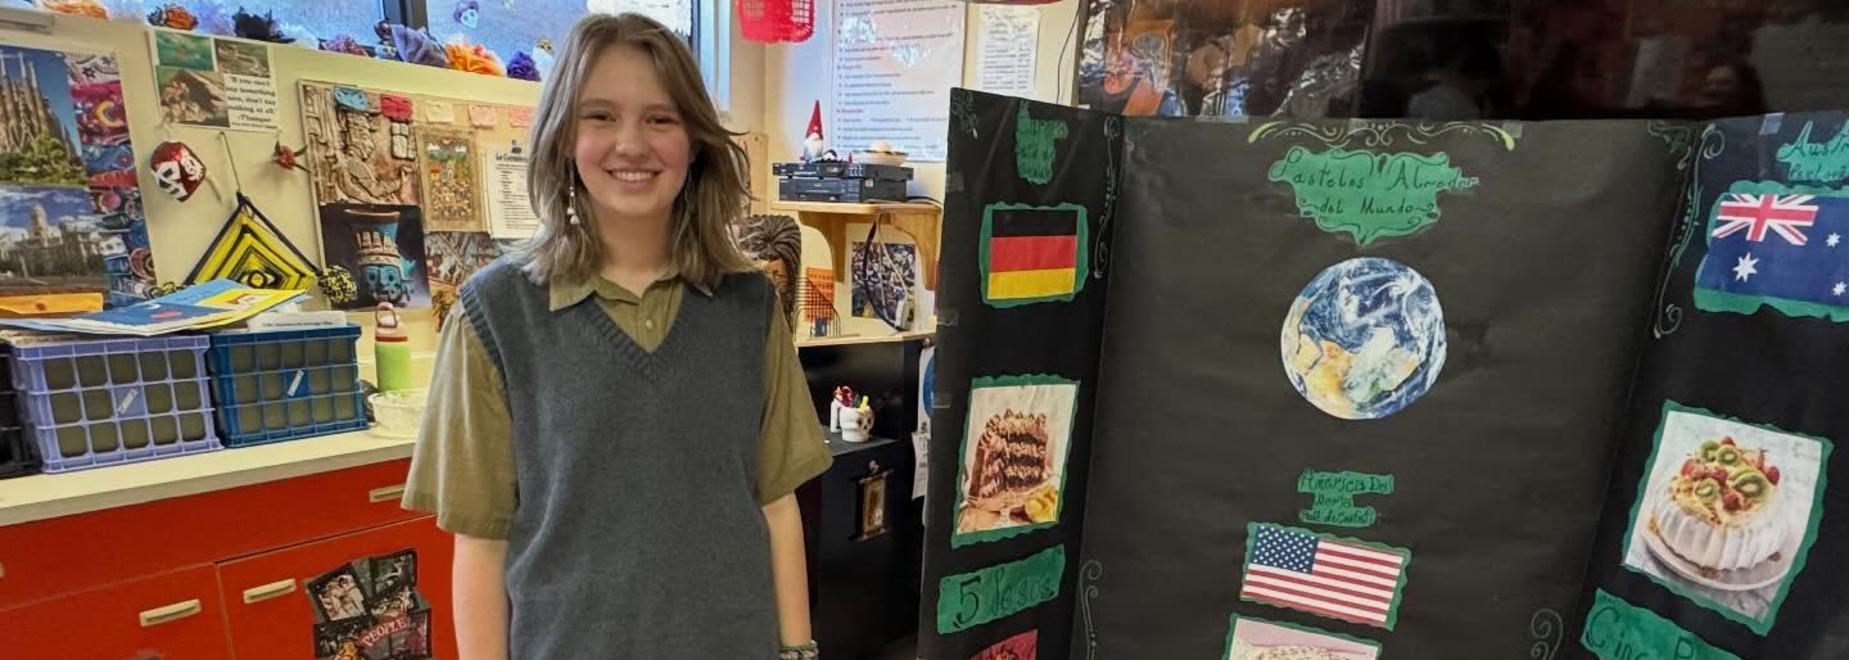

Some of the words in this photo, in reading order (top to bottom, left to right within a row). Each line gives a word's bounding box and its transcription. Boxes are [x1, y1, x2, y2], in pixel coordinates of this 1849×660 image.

[1319, 198, 1344, 215] del
[1360, 196, 1414, 215] Mundo
[953, 575, 982, 629] 5
